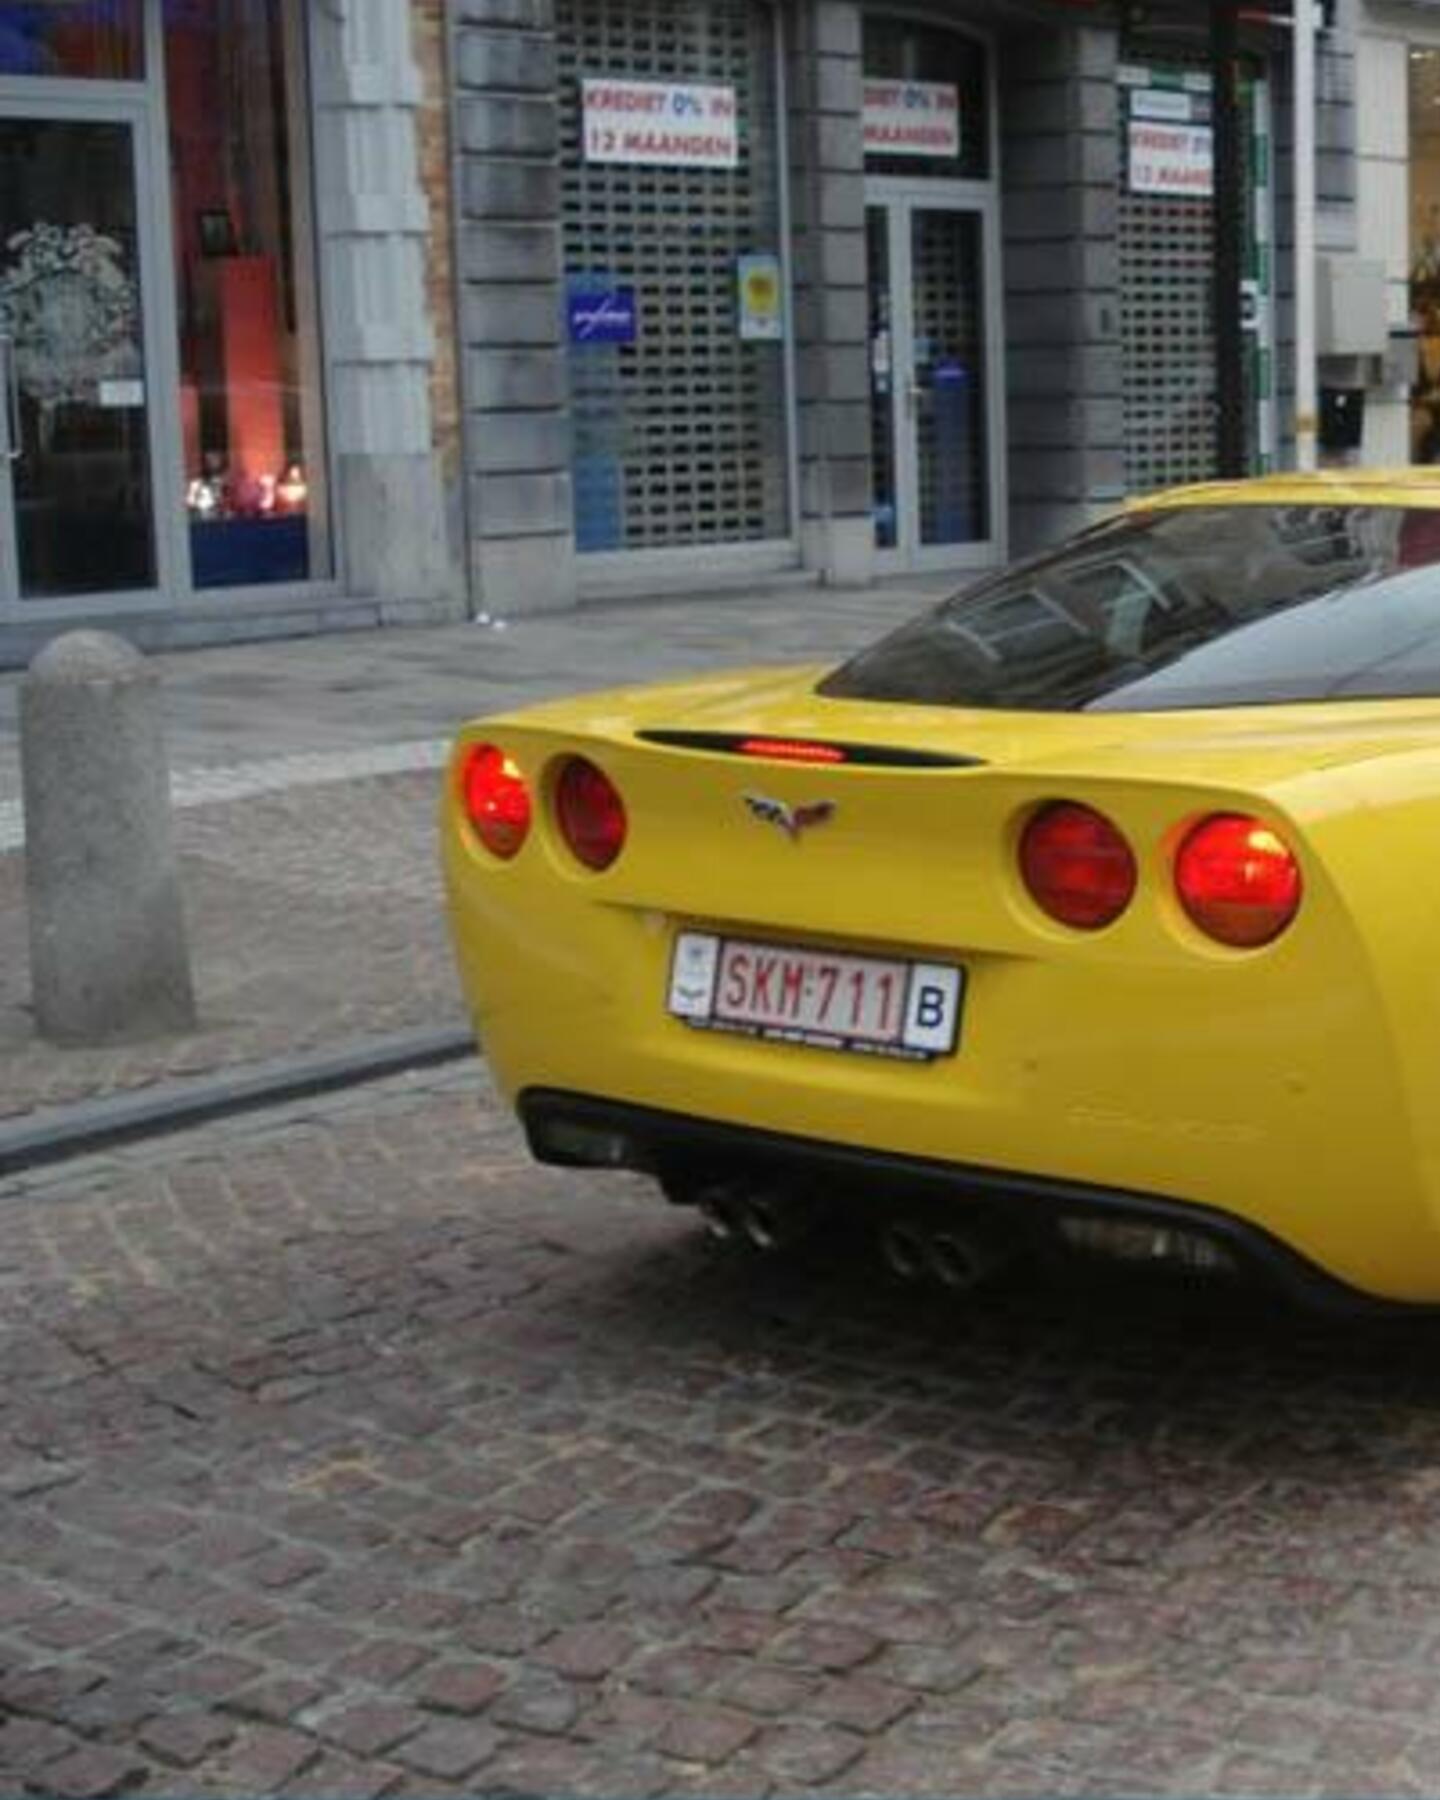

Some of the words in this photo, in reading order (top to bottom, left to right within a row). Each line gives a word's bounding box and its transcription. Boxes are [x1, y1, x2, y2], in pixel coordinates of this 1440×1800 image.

[586, 86, 667, 114] KREDIET
[673, 91, 703, 116] 0%
[711, 97, 732, 118] IN
[592, 128, 617, 153] 12
[623, 130, 732, 157] MAANDEN
[915, 985, 946, 1029] B
